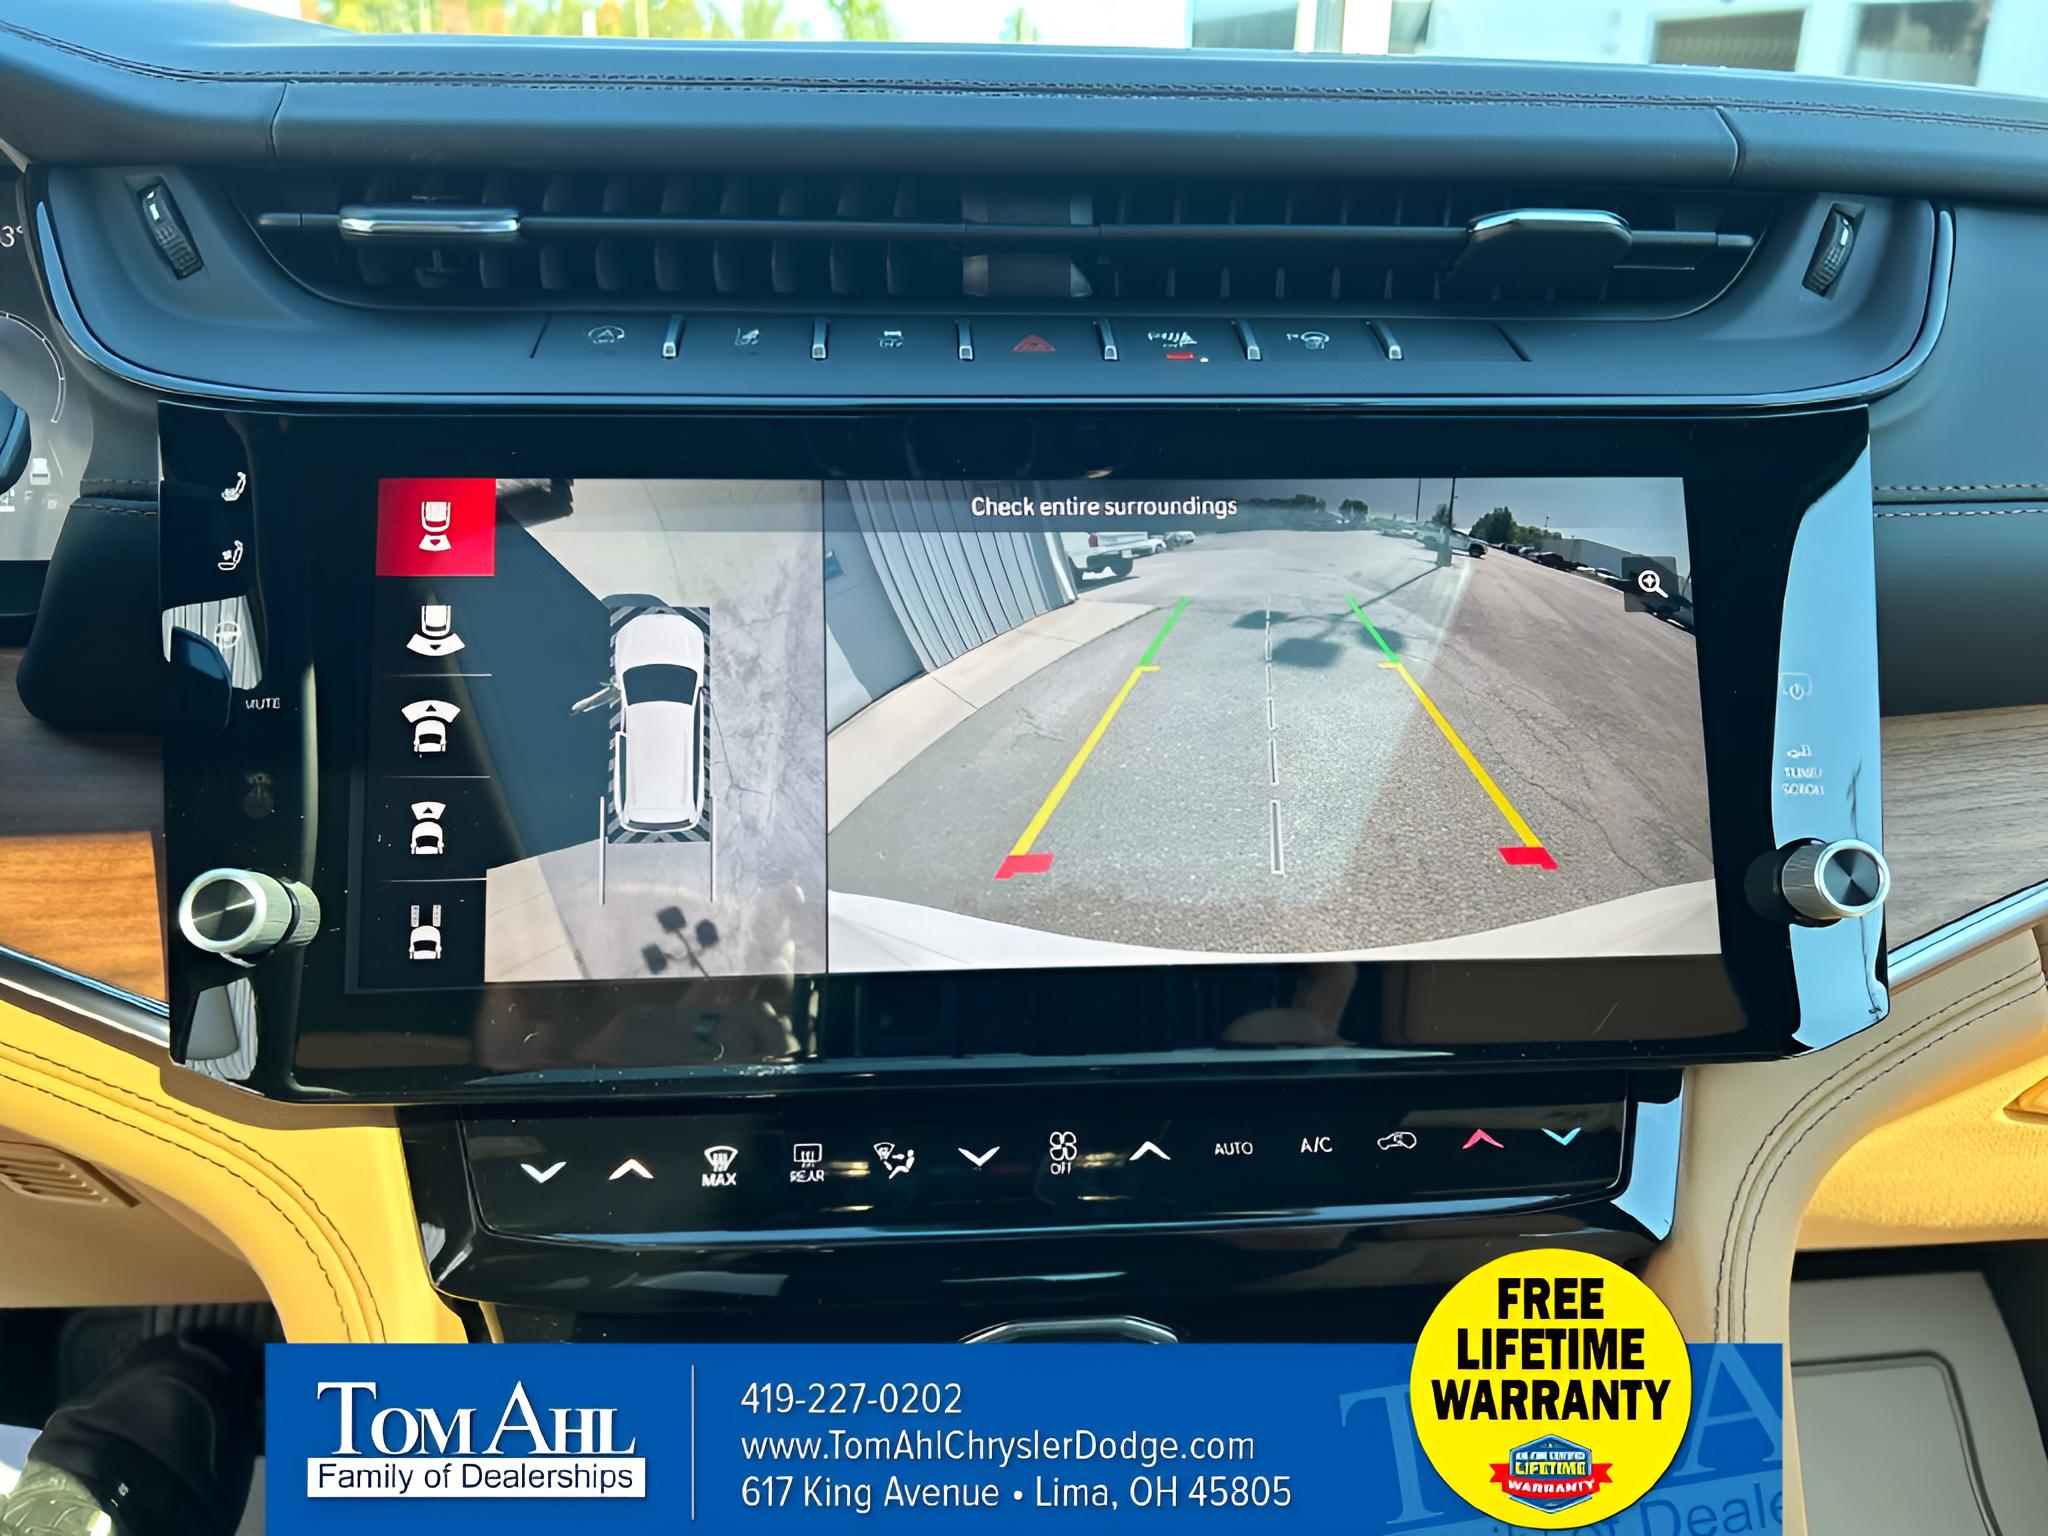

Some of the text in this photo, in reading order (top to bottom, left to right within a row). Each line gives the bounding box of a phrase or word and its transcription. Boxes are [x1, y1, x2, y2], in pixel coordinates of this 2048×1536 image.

[971, 496, 1238, 520] Check entire surroundings
[1214, 1141, 1254, 1156] AUTO
[1300, 1136, 1333, 1153] A/C
[701, 1172, 737, 1187] MAX
[790, 1169, 825, 1183] REAR
